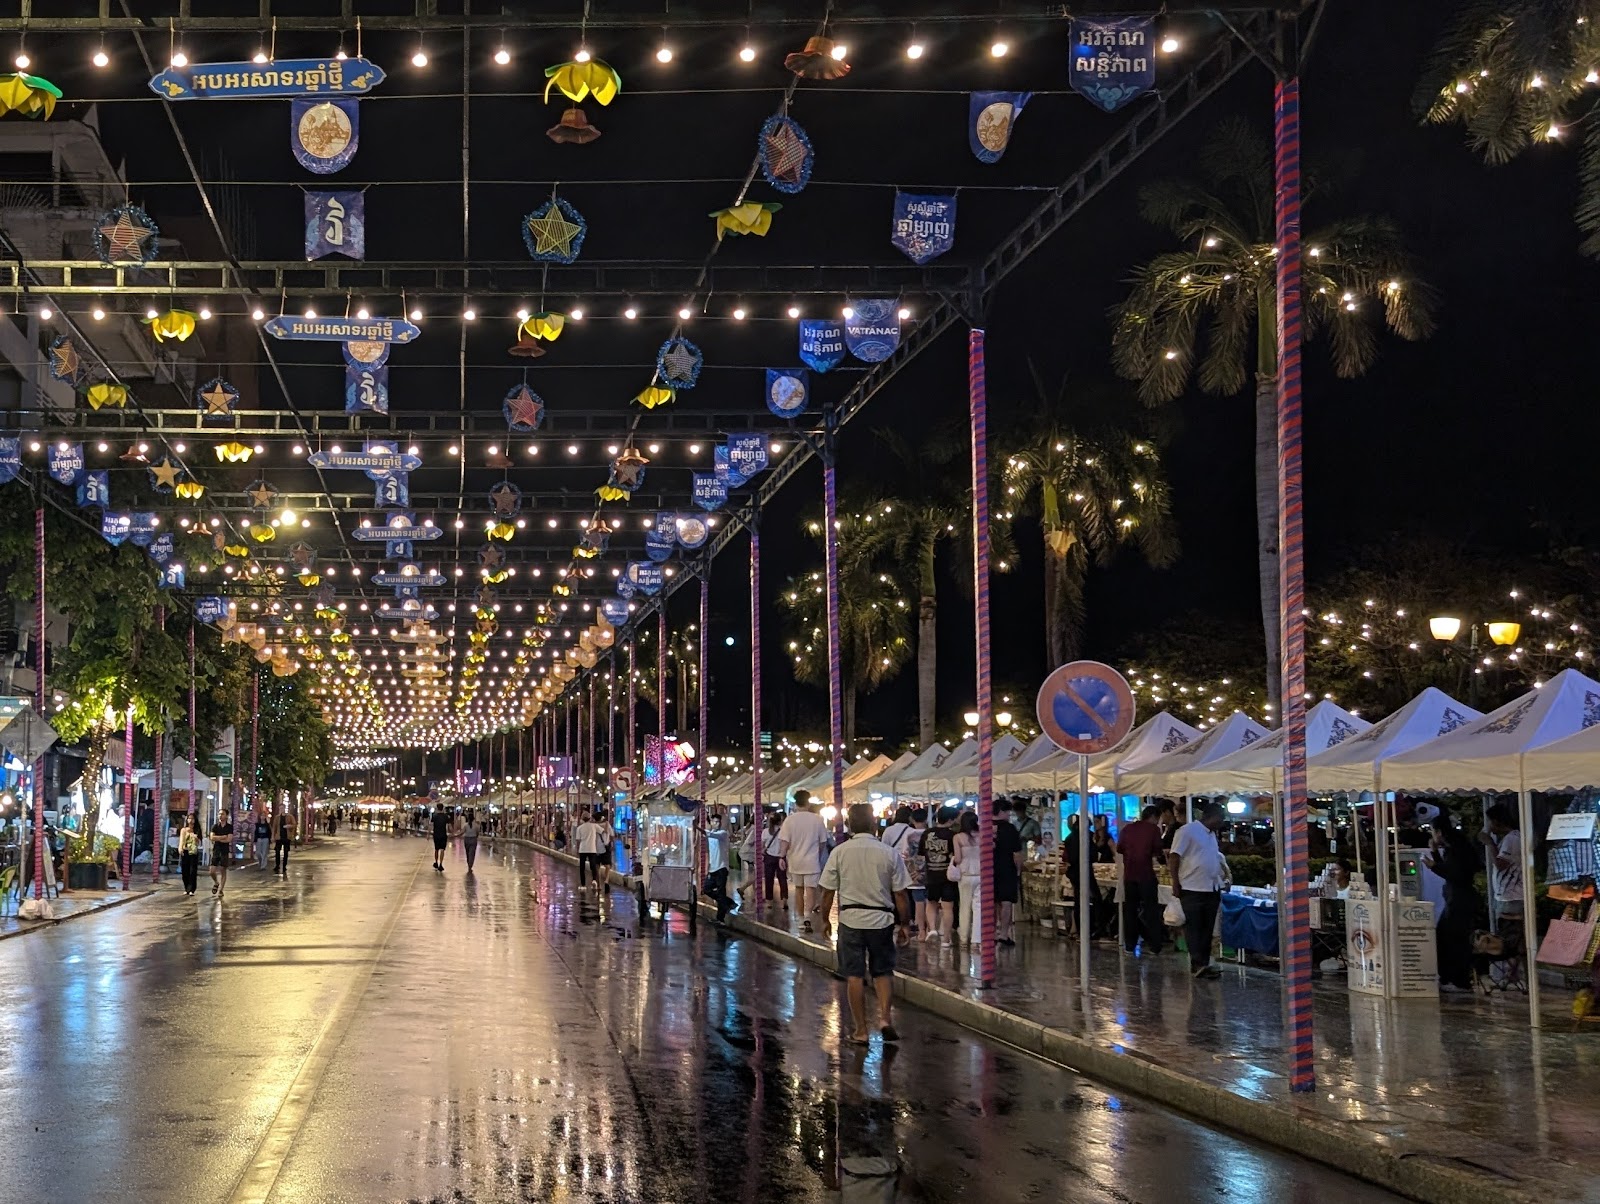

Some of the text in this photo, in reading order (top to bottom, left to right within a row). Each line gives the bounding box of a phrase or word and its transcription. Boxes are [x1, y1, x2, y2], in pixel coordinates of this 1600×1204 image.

[1079, 29, 1145, 51] អរគុណ
[192, 62, 344, 92] អបអរសាទរឆ្នាំថ្មី
[292, 321, 393, 342] អបអរសាទរឆ្នាំថ្មី
[328, 456, 402, 469] អបអរសាទរឆ្នាំថ្មី
